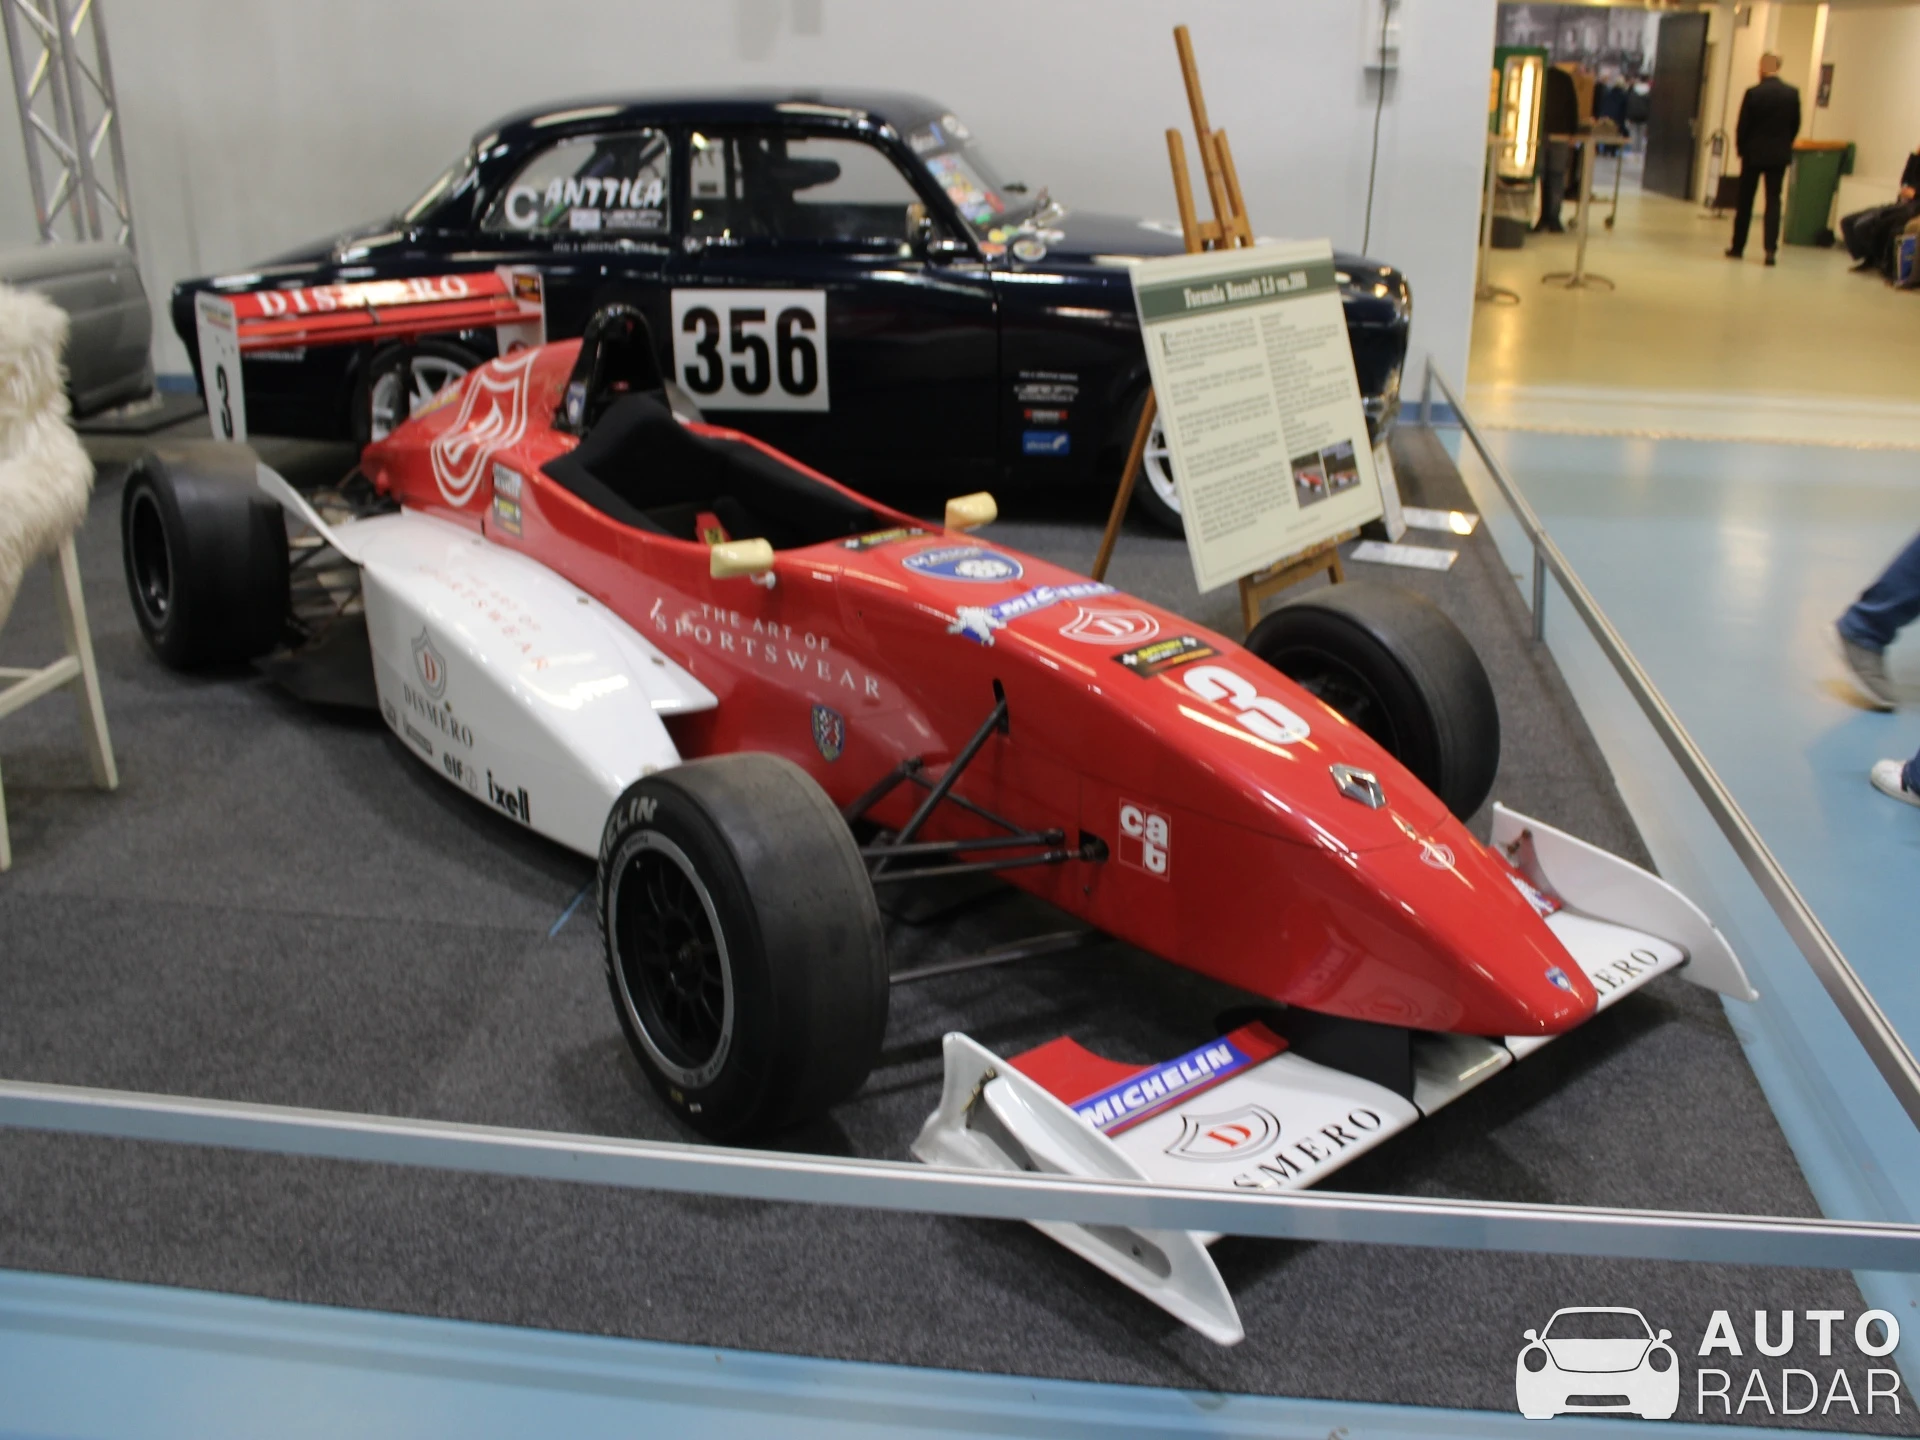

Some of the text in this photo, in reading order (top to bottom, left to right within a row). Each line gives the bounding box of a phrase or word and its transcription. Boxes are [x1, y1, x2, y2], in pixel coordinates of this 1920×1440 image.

[504, 184, 538, 229] C
[542, 177, 664, 209] ANTTILA
[255, 276, 468, 317] DISRO
[1226, 278, 1262, 302] Renault
[682, 304, 818, 397] 356
[216, 363, 234, 438] 3
[701, 603, 830, 651] THE ART OF
[655, 614, 880, 699] SPORTSWEAR
[403, 683, 474, 749] DISMERO
[1183, 665, 1311, 745] 3
[443, 752, 463, 781] elf
[487, 768, 531, 824] ixell
[1080, 1043, 1234, 1129] MICHELIN
[1205, 1124, 1252, 1148] D
[1233, 1108, 1382, 1189] SMERO
